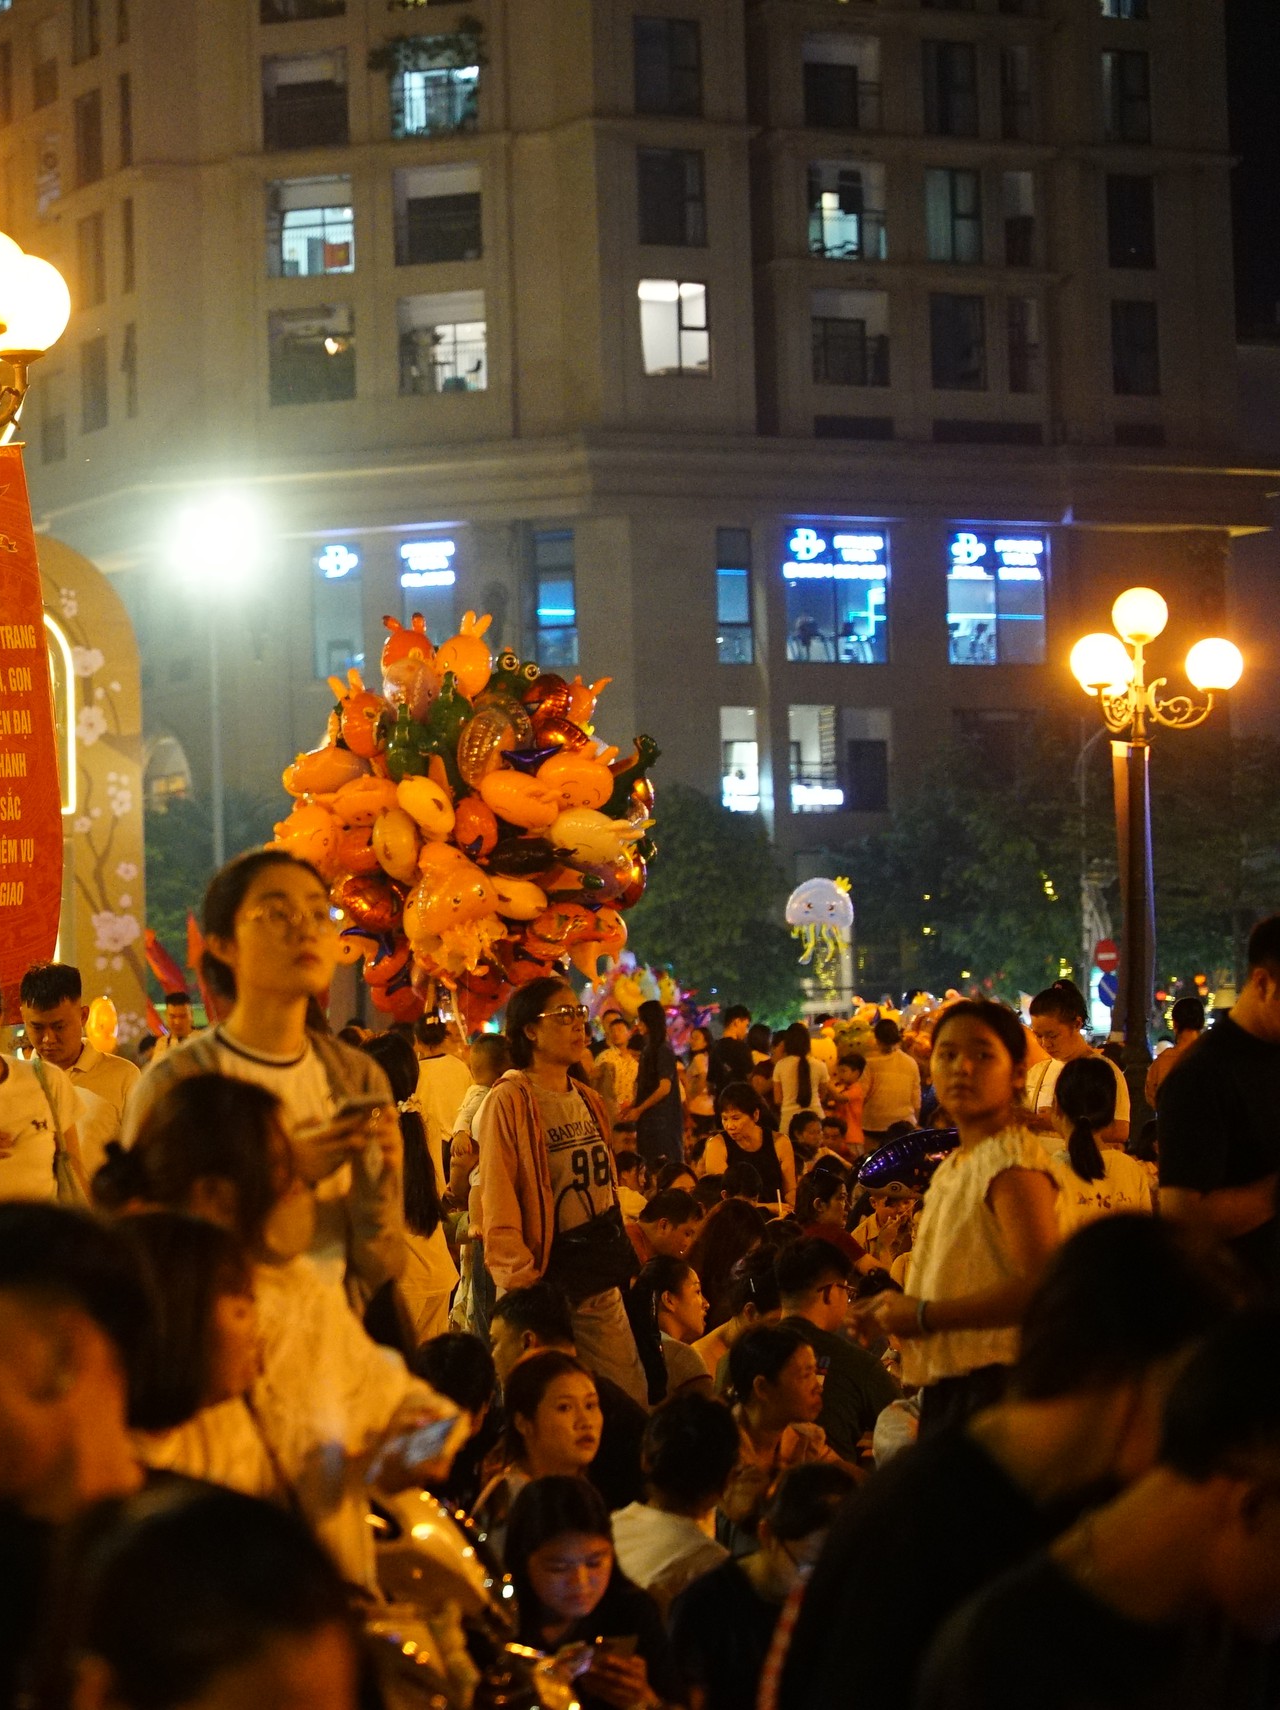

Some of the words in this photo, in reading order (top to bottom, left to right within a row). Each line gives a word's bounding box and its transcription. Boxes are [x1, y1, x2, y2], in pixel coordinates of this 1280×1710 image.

[8, 667, 32, 697] GỌN
[12, 709, 32, 740] ĐẠI
[0, 786, 21, 821] SẮC
[20, 838, 34, 868] VỤ
[0, 881, 24, 907] GIAO
[572, 1145, 610, 1192] 98
